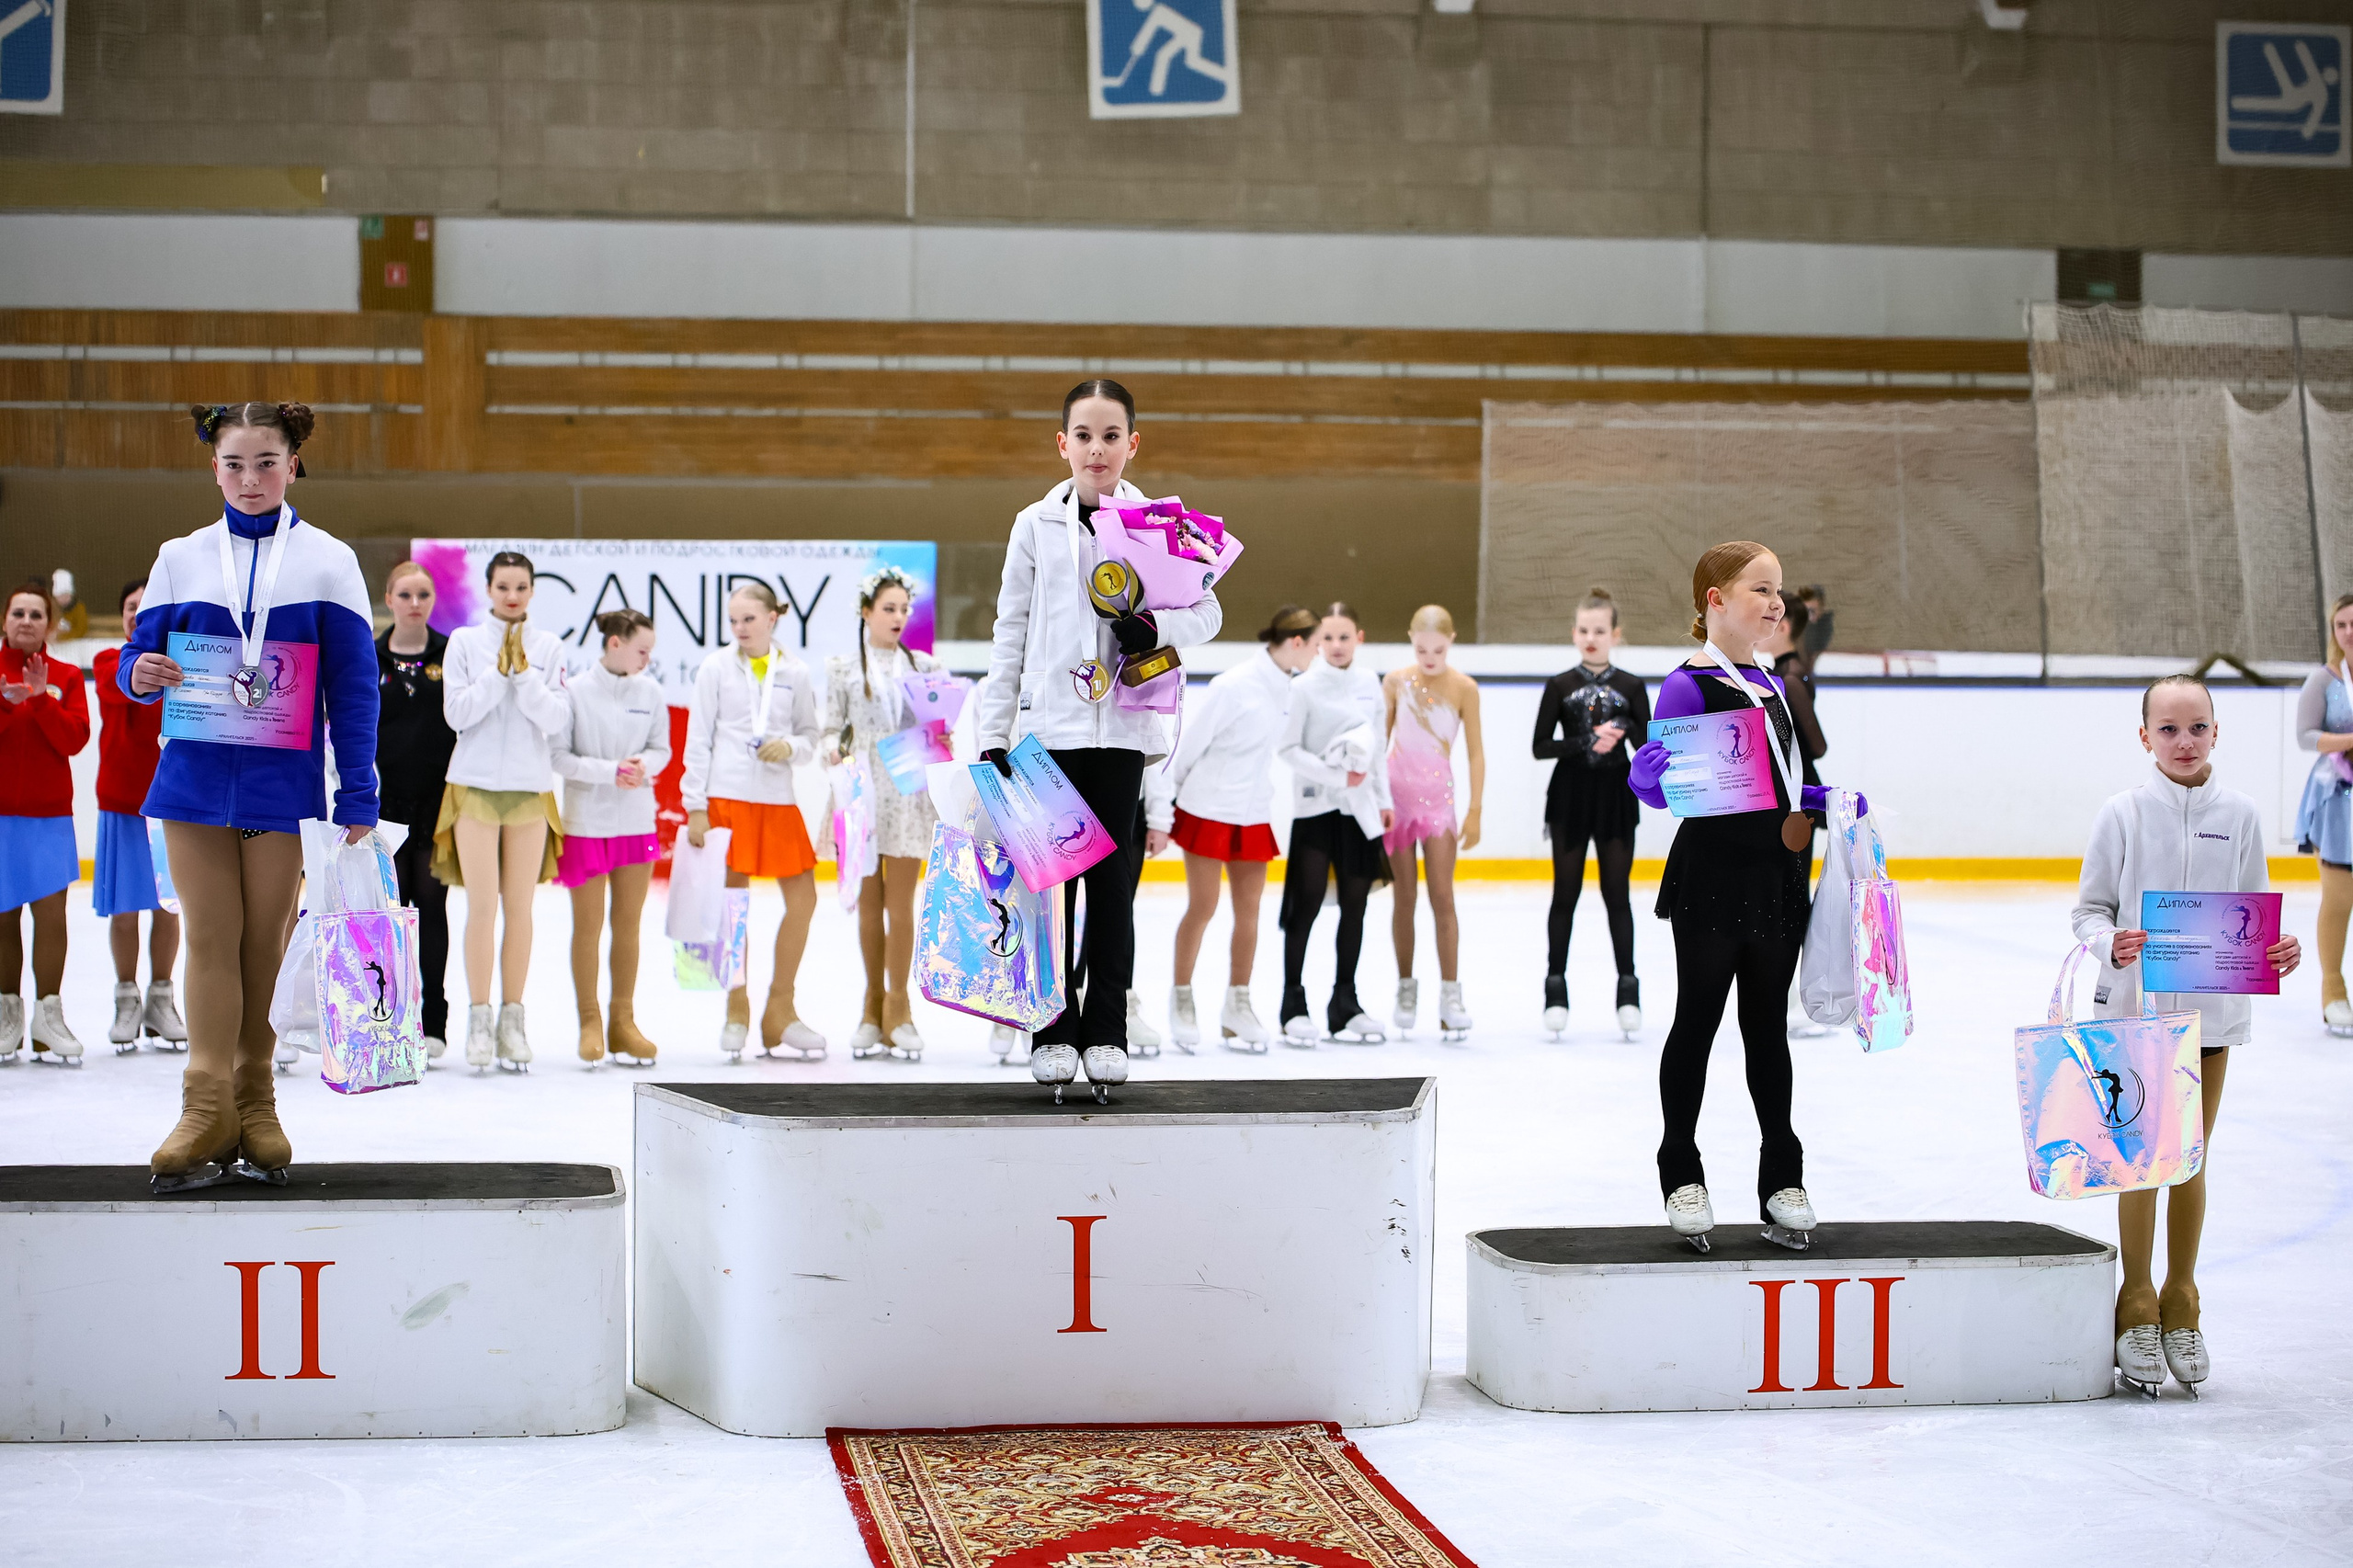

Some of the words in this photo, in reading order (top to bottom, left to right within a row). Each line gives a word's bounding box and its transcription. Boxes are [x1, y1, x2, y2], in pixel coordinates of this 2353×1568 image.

[277, 682, 301, 699] CANDY
[1717, 750, 1738, 766] КУБОК
[1739, 746, 1756, 765] CANDY
[1046, 822, 1056, 846] КУБОК
[1052, 846, 1077, 861] CANDY
[2199, 832, 2230, 840] Архангельск
[2221, 929, 2243, 947] КУБОК
[2245, 930, 2266, 948] CANDY
[2120, 1130, 2143, 1139] CANDY
[223, 1261, 336, 1380] II
[1747, 1277, 1905, 1393] III
